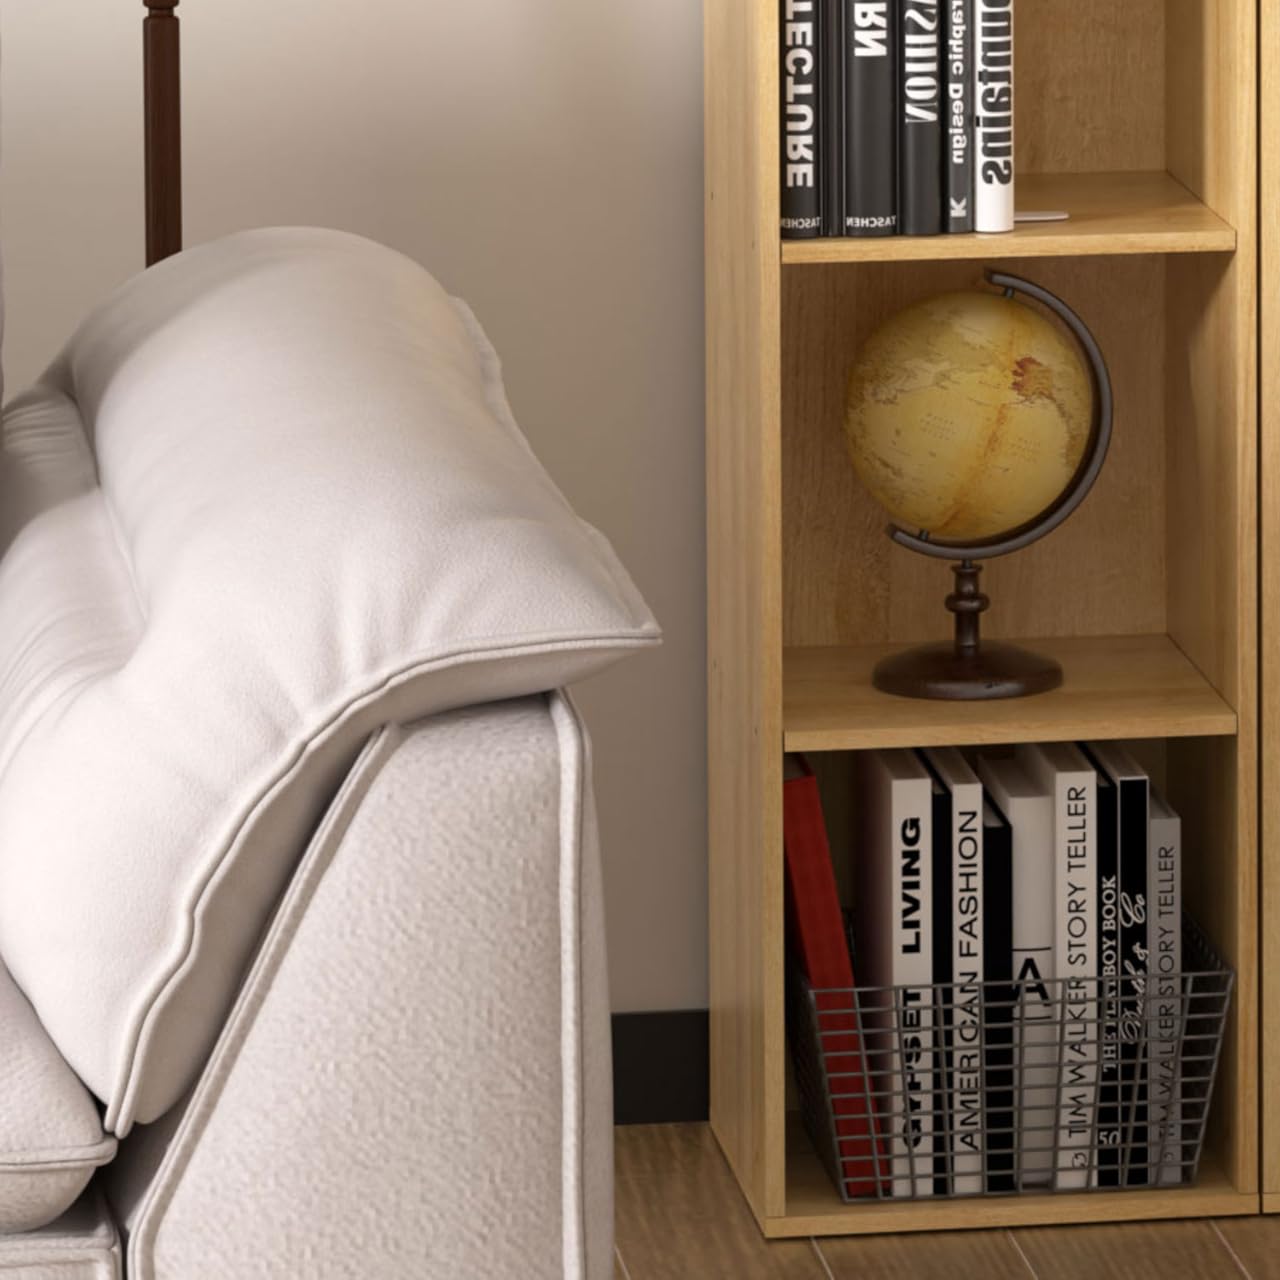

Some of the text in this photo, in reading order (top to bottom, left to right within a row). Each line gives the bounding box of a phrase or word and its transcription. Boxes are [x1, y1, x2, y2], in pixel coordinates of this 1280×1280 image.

[1067, 785, 1087, 875] TELLER
[901, 816, 922, 955] LIVING
[1067, 881, 1087, 966] STORY
[1102, 875, 1117, 932] BOOK
[1157, 845, 1175, 918] TELLER
[957, 809, 979, 1151] AMERCAN FASHION
[1158, 925, 1175, 997] STORY
